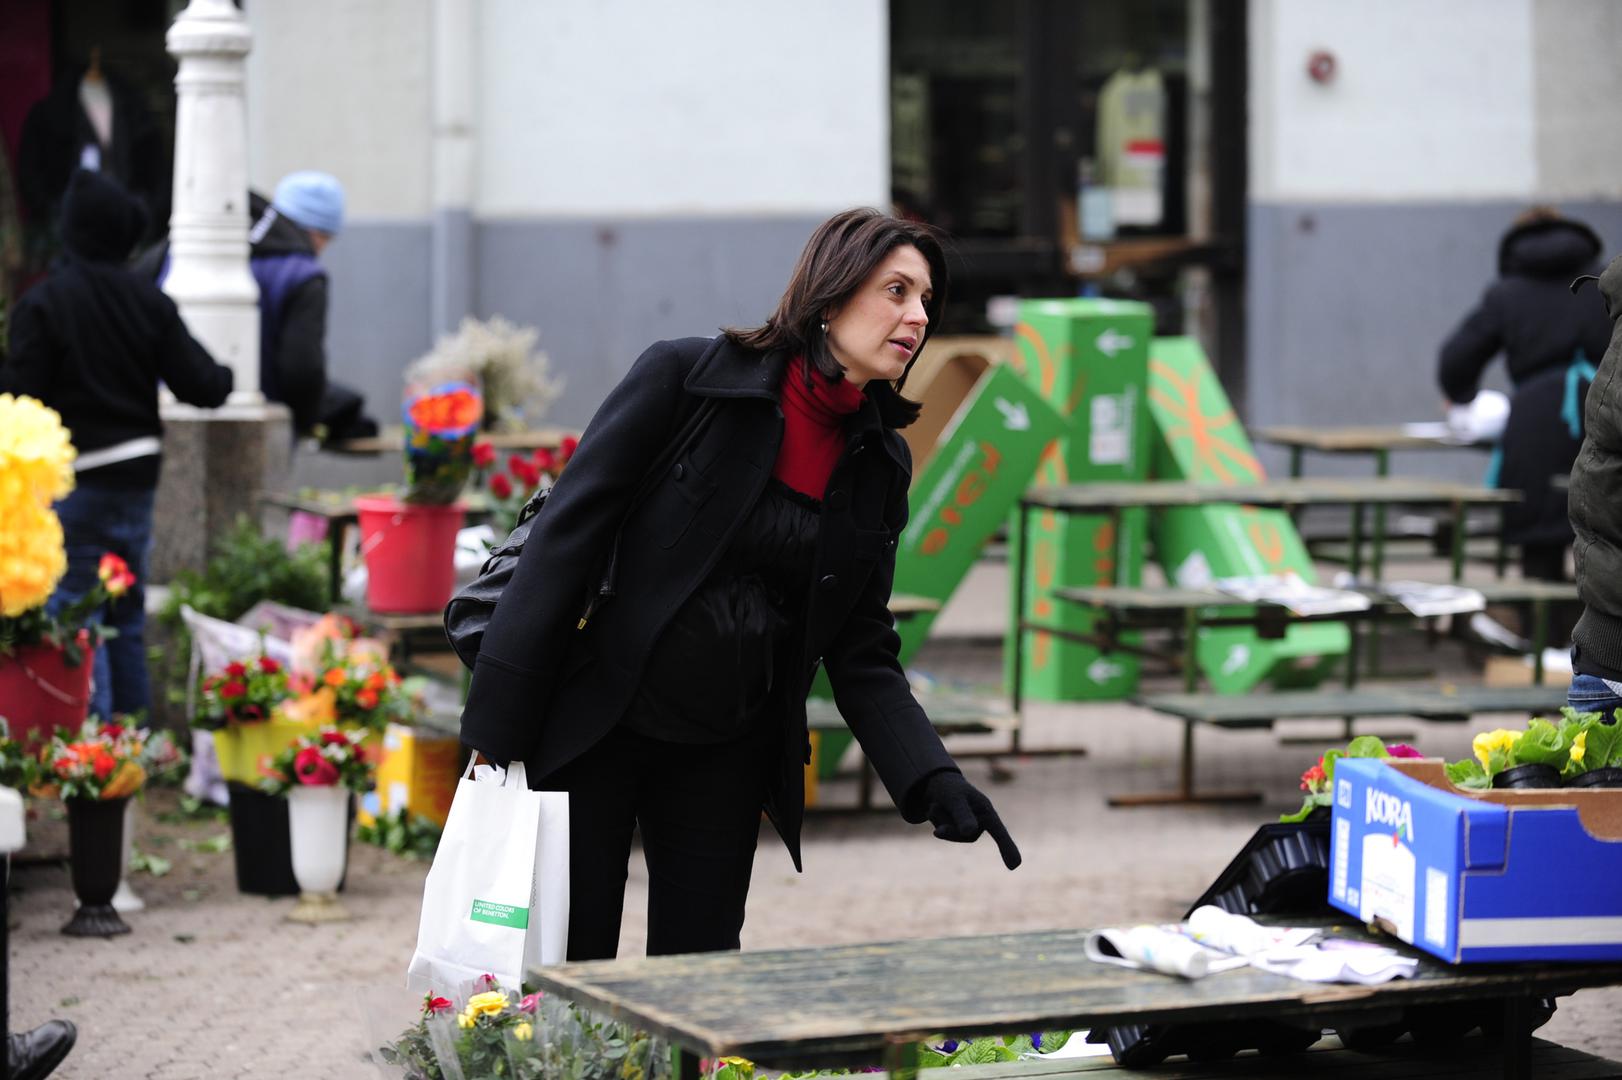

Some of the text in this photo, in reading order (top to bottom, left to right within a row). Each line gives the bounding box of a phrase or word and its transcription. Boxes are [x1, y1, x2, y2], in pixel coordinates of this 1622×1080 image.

[1365, 786, 1414, 843] KORA
[474, 900, 515, 914] UNITED COLORS
